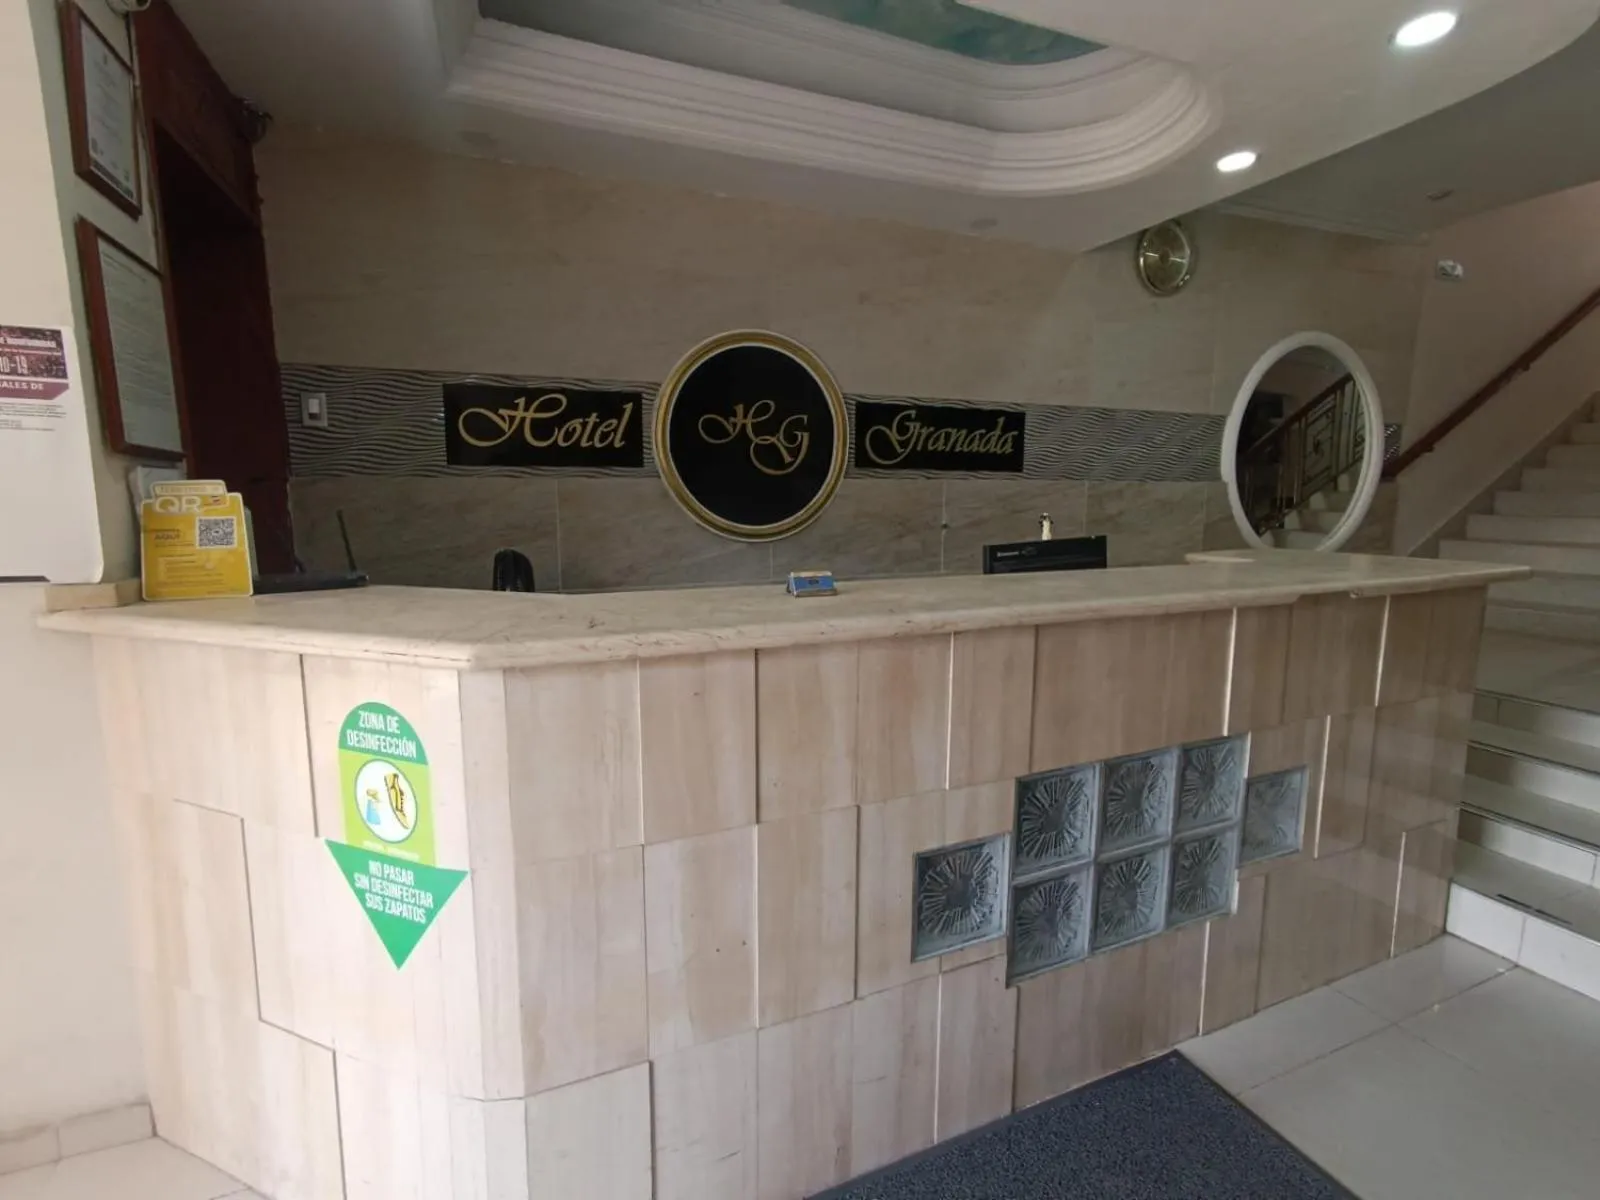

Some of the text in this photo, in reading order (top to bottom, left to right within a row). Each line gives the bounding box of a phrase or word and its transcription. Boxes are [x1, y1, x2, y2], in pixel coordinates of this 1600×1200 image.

[458, 393, 634, 449] Hotel
[865, 409, 1019, 465] Granada
[155, 495, 200, 513] QR
[358, 710, 401, 734] ZONA DE
[346, 729, 417, 759] DESINFECCIÓN
[368, 860, 415, 887] NO PASAR
[354, 872, 434, 909] SIN DESINFECTAR
[365, 892, 426, 925] SUS ZAPATOS
